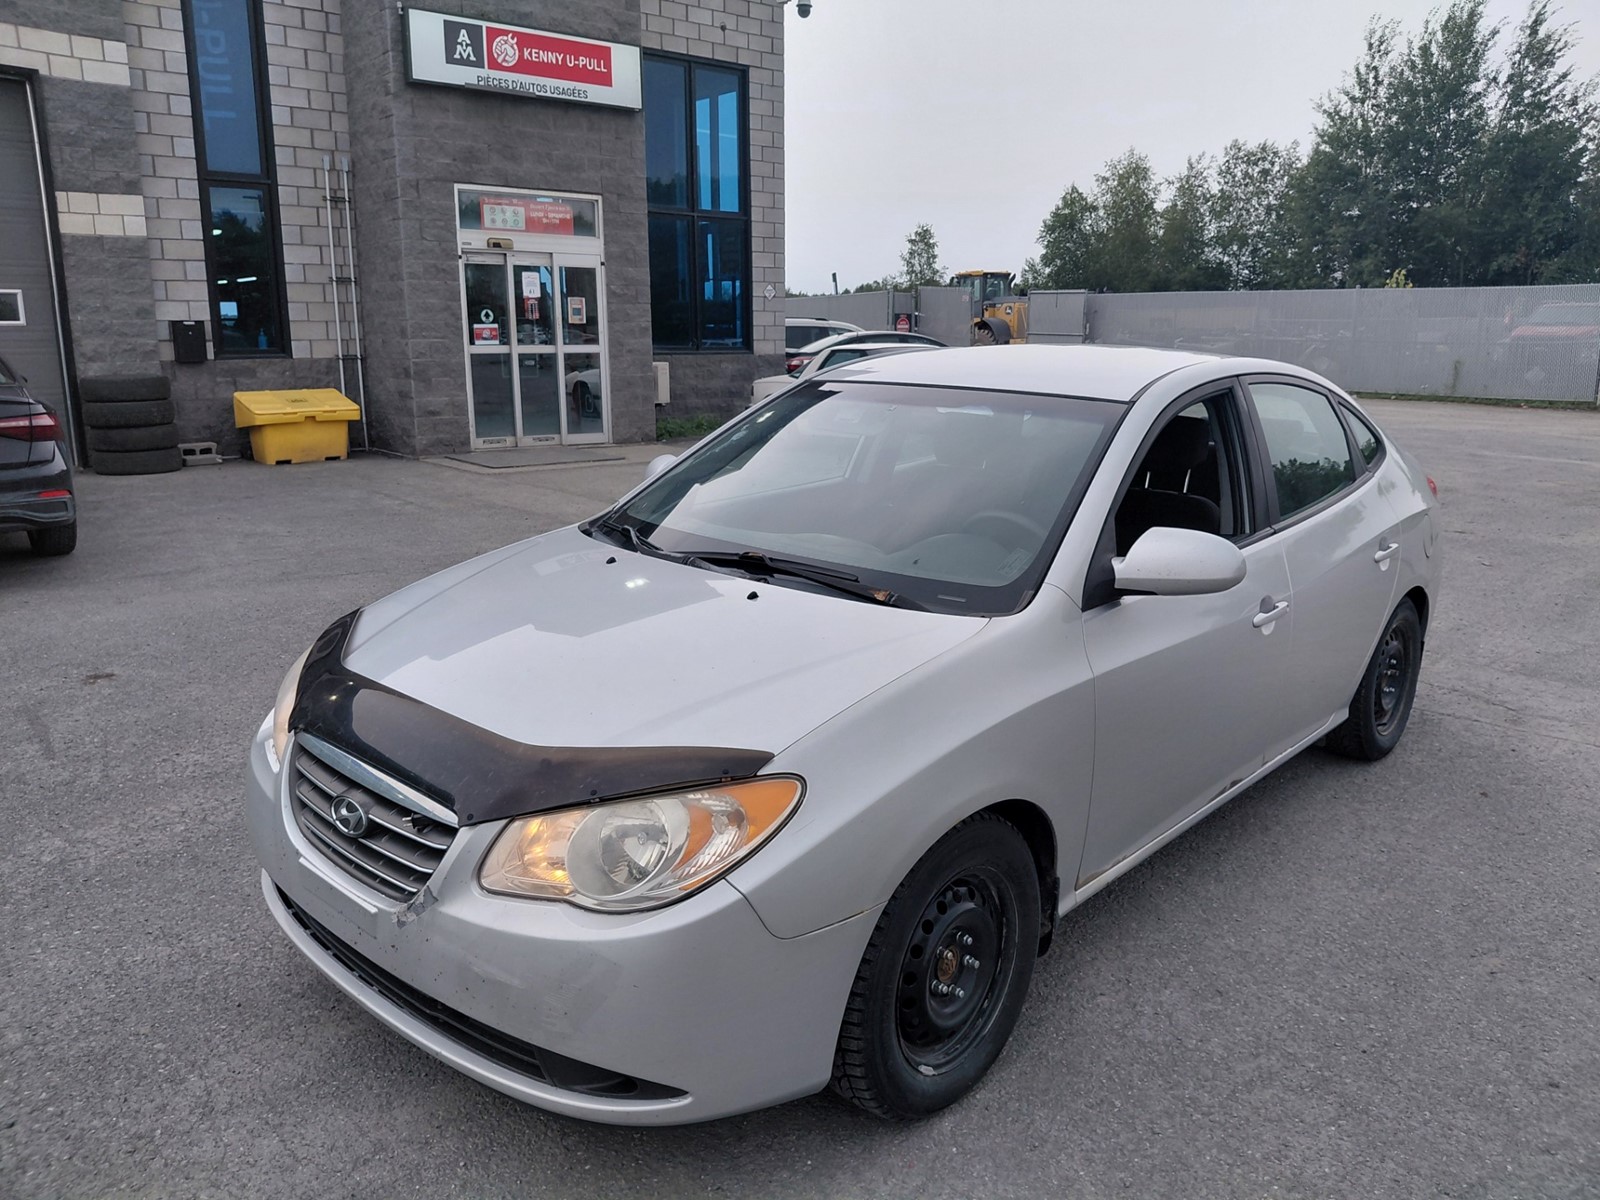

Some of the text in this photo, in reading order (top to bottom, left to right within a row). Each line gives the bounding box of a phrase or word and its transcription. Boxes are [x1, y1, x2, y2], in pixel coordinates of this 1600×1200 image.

[523, 47, 608, 72] KENNY U-PULL
[476, 74, 588, 100] PIÈCES D'AUTOS USAGÉES
